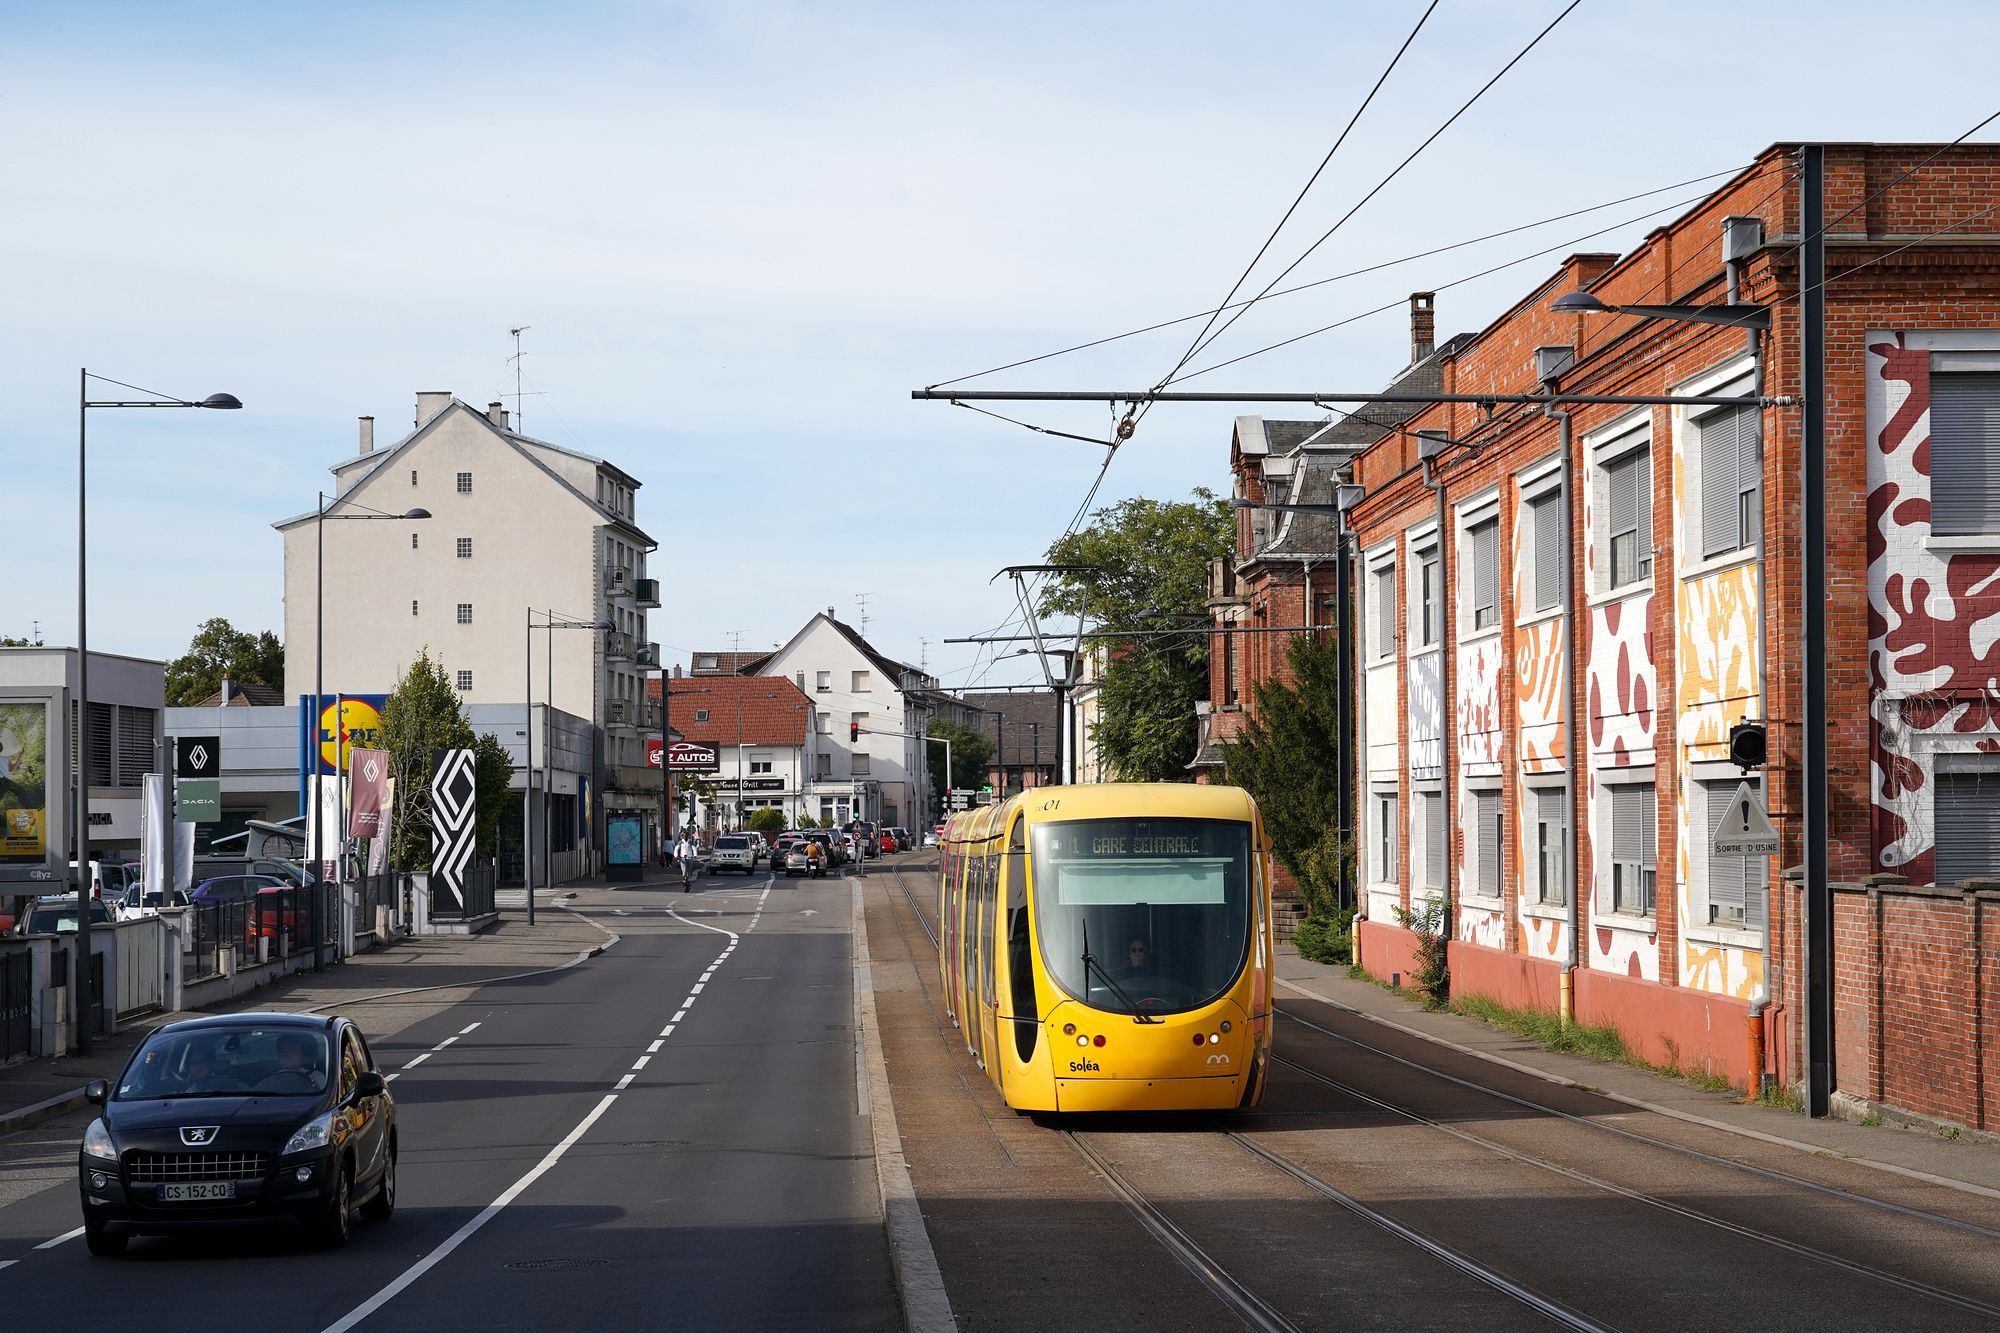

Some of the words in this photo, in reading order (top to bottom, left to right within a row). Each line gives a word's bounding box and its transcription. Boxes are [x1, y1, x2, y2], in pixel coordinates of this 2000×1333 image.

[676, 753, 715, 762] AUTOS
[1093, 837, 1127, 854] GARE
[1716, 845, 1742, 853] SORTIE
[1747, 843, 1777, 852] D'USINE
[1070, 1057, 1100, 1072] Soléa
